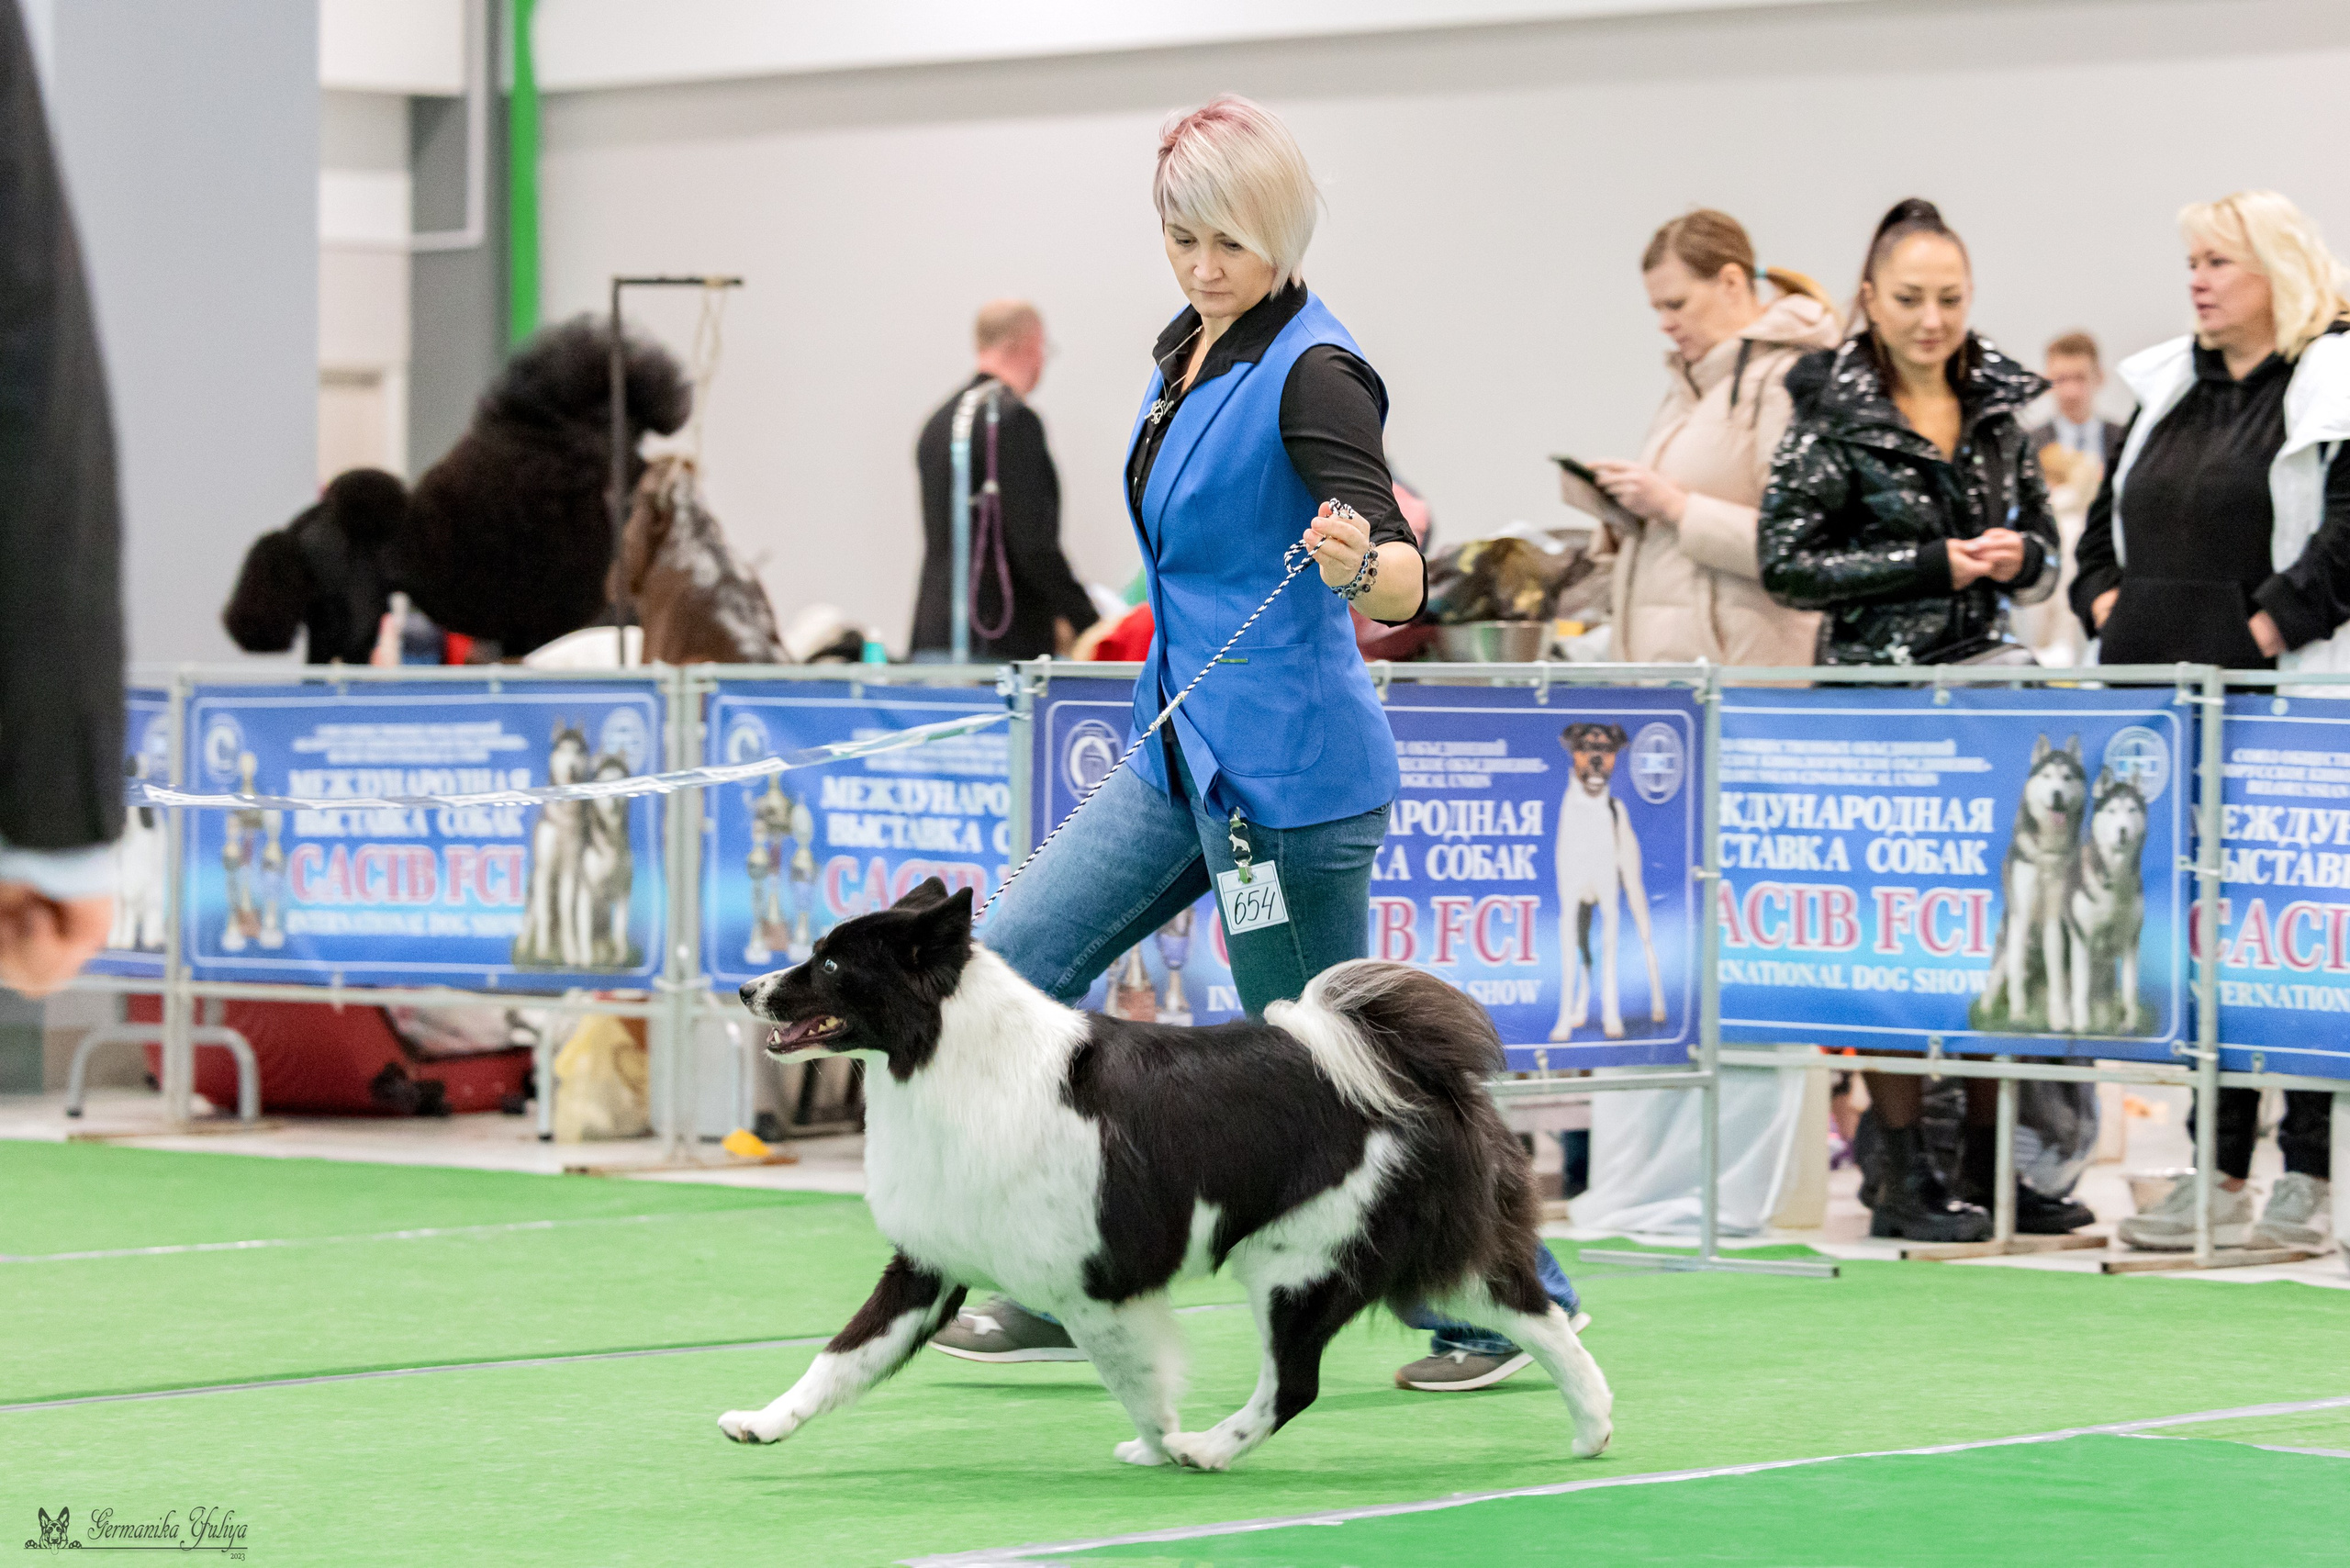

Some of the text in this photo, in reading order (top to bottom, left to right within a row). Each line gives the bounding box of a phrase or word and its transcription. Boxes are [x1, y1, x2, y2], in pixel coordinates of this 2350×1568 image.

[288, 842, 527, 906] CACIB FCI
[1425, 843, 1539, 881] СОБАК
[1865, 836, 1989, 876] СОБАК
[2196, 846, 2350, 890] ЫСТАВ
[1234, 886, 1276, 925] 654
[1870, 885, 1994, 958] FCI
[1429, 893, 1542, 969] FCI
[1466, 979, 1542, 1006] SHOW
[1851, 966, 1910, 993] DOG
[1912, 968, 1992, 996] SHOW
